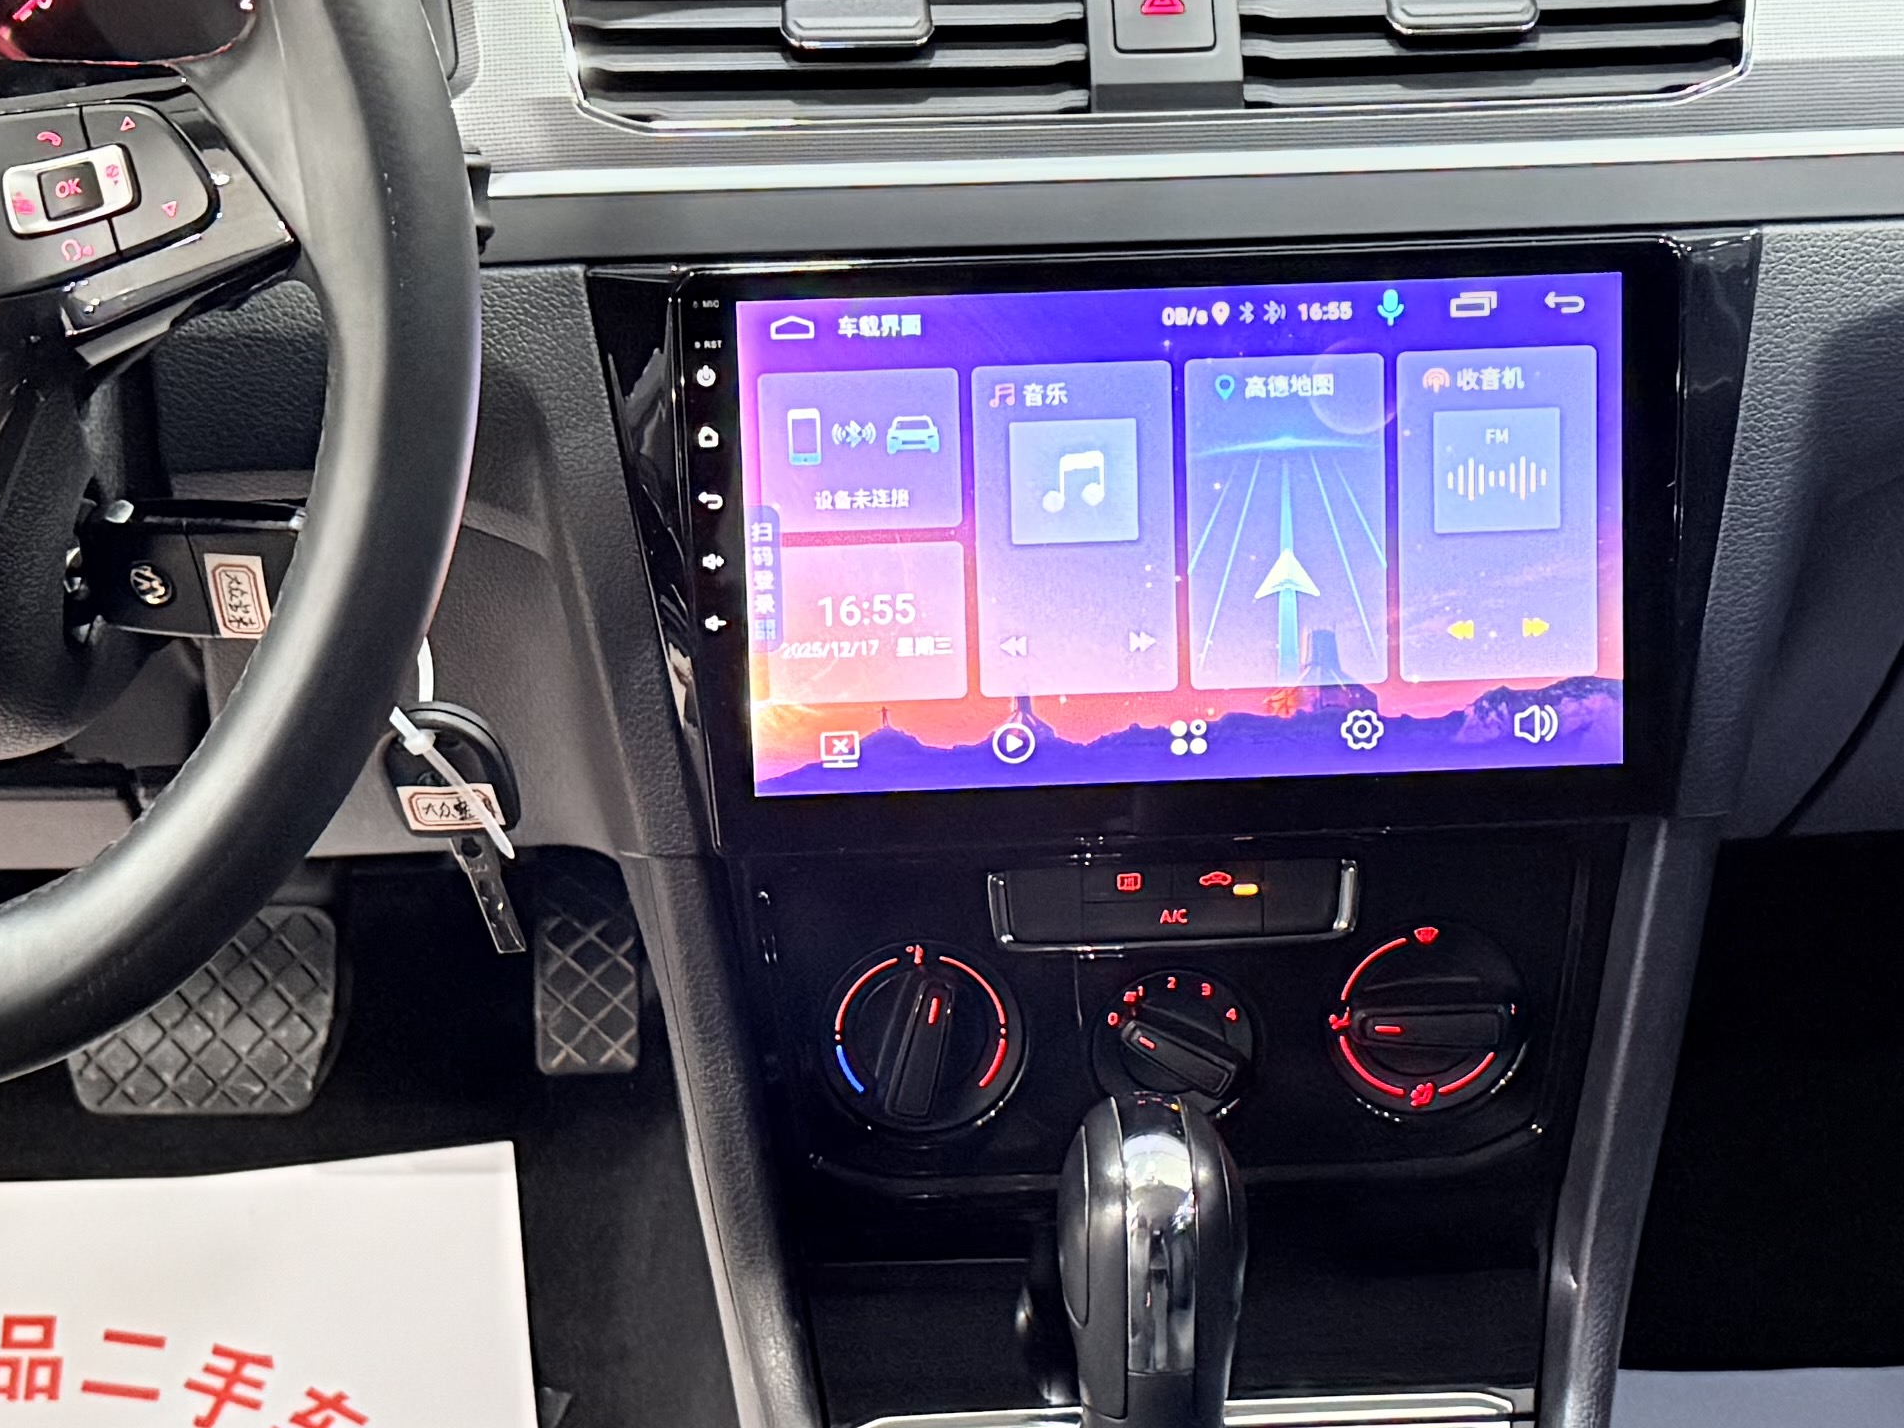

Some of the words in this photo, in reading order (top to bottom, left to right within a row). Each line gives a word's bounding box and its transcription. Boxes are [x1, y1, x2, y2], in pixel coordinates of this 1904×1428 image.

[54, 177, 83, 199] OK
[1297, 301, 1353, 322] 16:55
[837, 314, 922, 338] 车载界面
[1244, 373, 1335, 399] 高德地图
[1456, 365, 1526, 391] 收音机
[1022, 382, 1069, 407] 音乐
[1485, 427, 1510, 445] FM
[814, 488, 910, 510] 设备未连接
[750, 521, 777, 614] 扫码登录
[817, 592, 917, 628] 16:55
[781, 638, 880, 660] 2025/12/17
[895, 635, 954, 657] 星期三
[1159, 908, 1189, 924] A/C
[1137, 985, 1145, 997] 1
[1166, 976, 1177, 989] 2
[1200, 982, 1212, 996] 3
[1107, 1011, 1119, 1026] 0
[1225, 1007, 1238, 1021] 4
